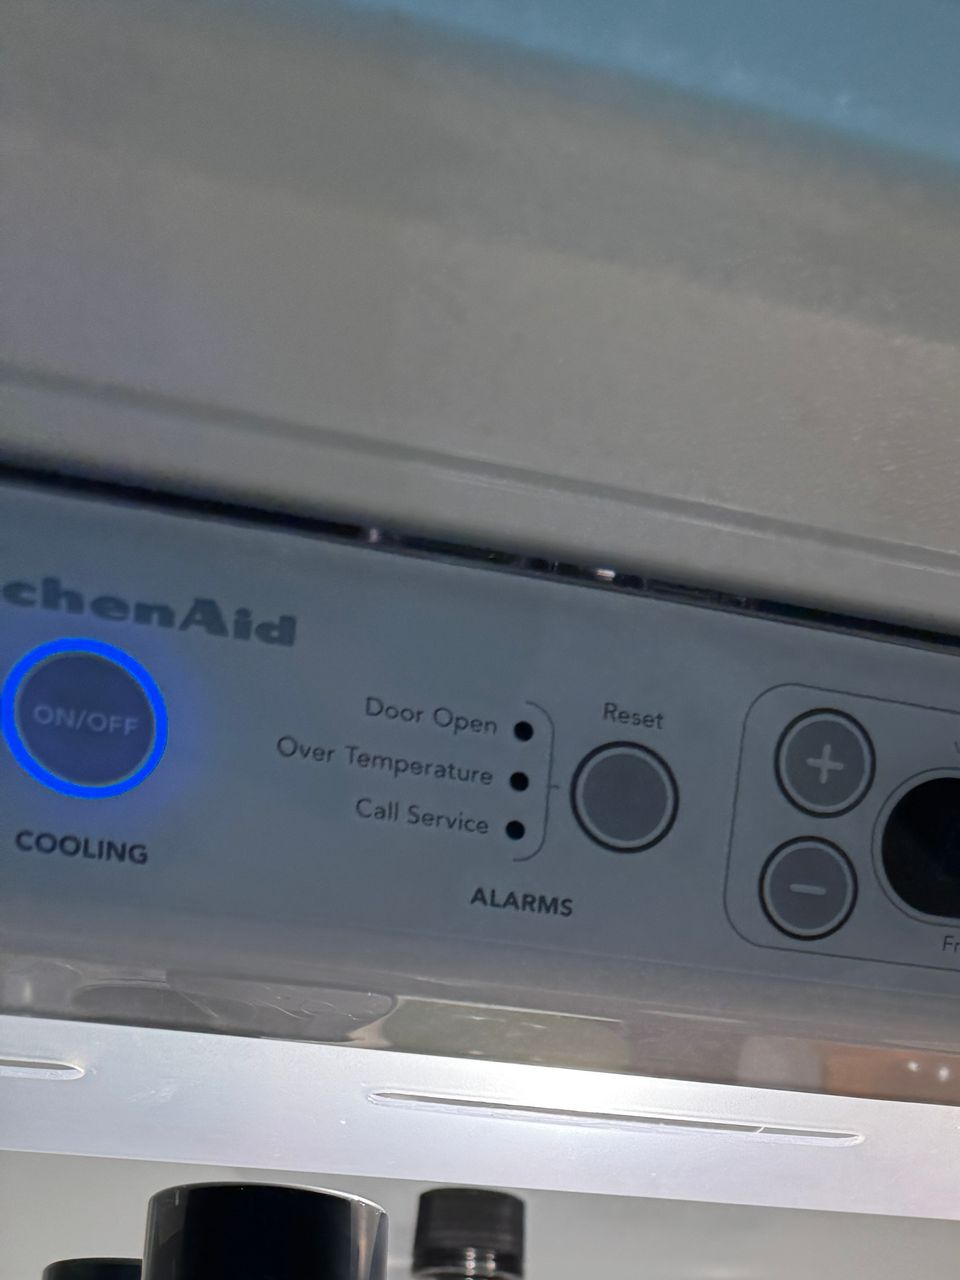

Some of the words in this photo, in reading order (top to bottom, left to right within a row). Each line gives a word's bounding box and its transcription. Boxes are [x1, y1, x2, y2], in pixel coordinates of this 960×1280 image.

[33, 704, 139, 736] ON/OFF
[365, 696, 424, 723] Door
[433, 706, 498, 735] Open
[603, 702, 664, 730] Reset
[276, 735, 336, 763] Over
[344, 745, 494, 786] Temperature
[355, 798, 400, 822] Call
[407, 804, 489, 835] Service
[15, 829, 149, 865] COOLING
[470, 886, 574, 917] ALARMS
